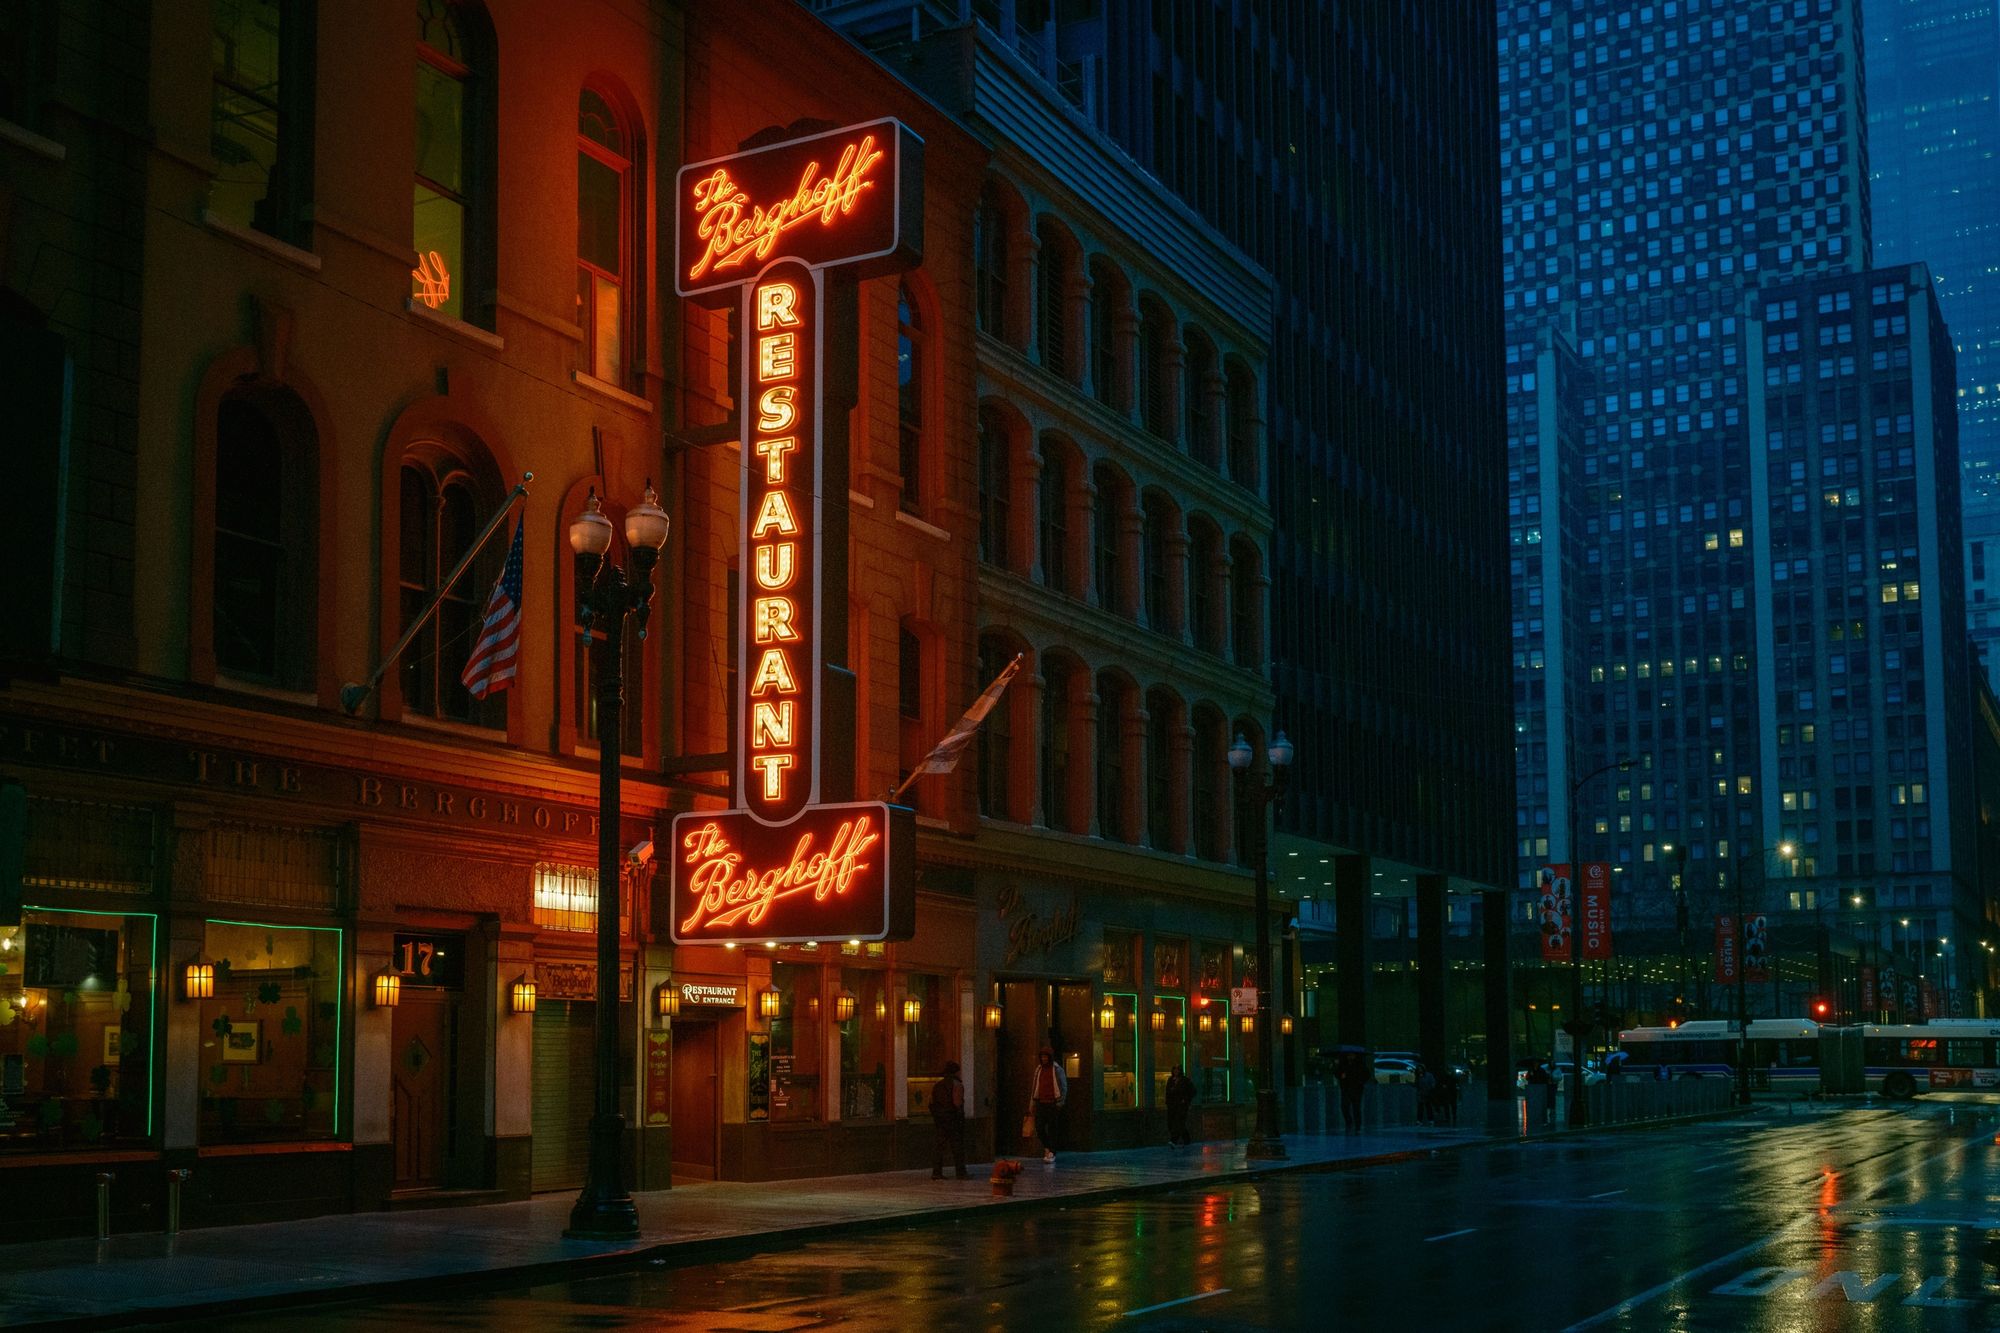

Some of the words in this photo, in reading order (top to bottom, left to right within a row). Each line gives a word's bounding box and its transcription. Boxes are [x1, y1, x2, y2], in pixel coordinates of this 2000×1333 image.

[690, 136, 882, 280] Berghoff
[694, 169, 738, 210] The
[752, 282, 801, 800] RESTAURANT
[191, 752, 301, 792] THE
[684, 823, 729, 863] The
[681, 817, 878, 934] Berghoff
[1587, 895, 1600, 948] MUSIC
[401, 941, 434, 976] 17
[682, 983, 737, 1003] RESTAURANT
[702, 996, 735, 1005] ENTRANCE
